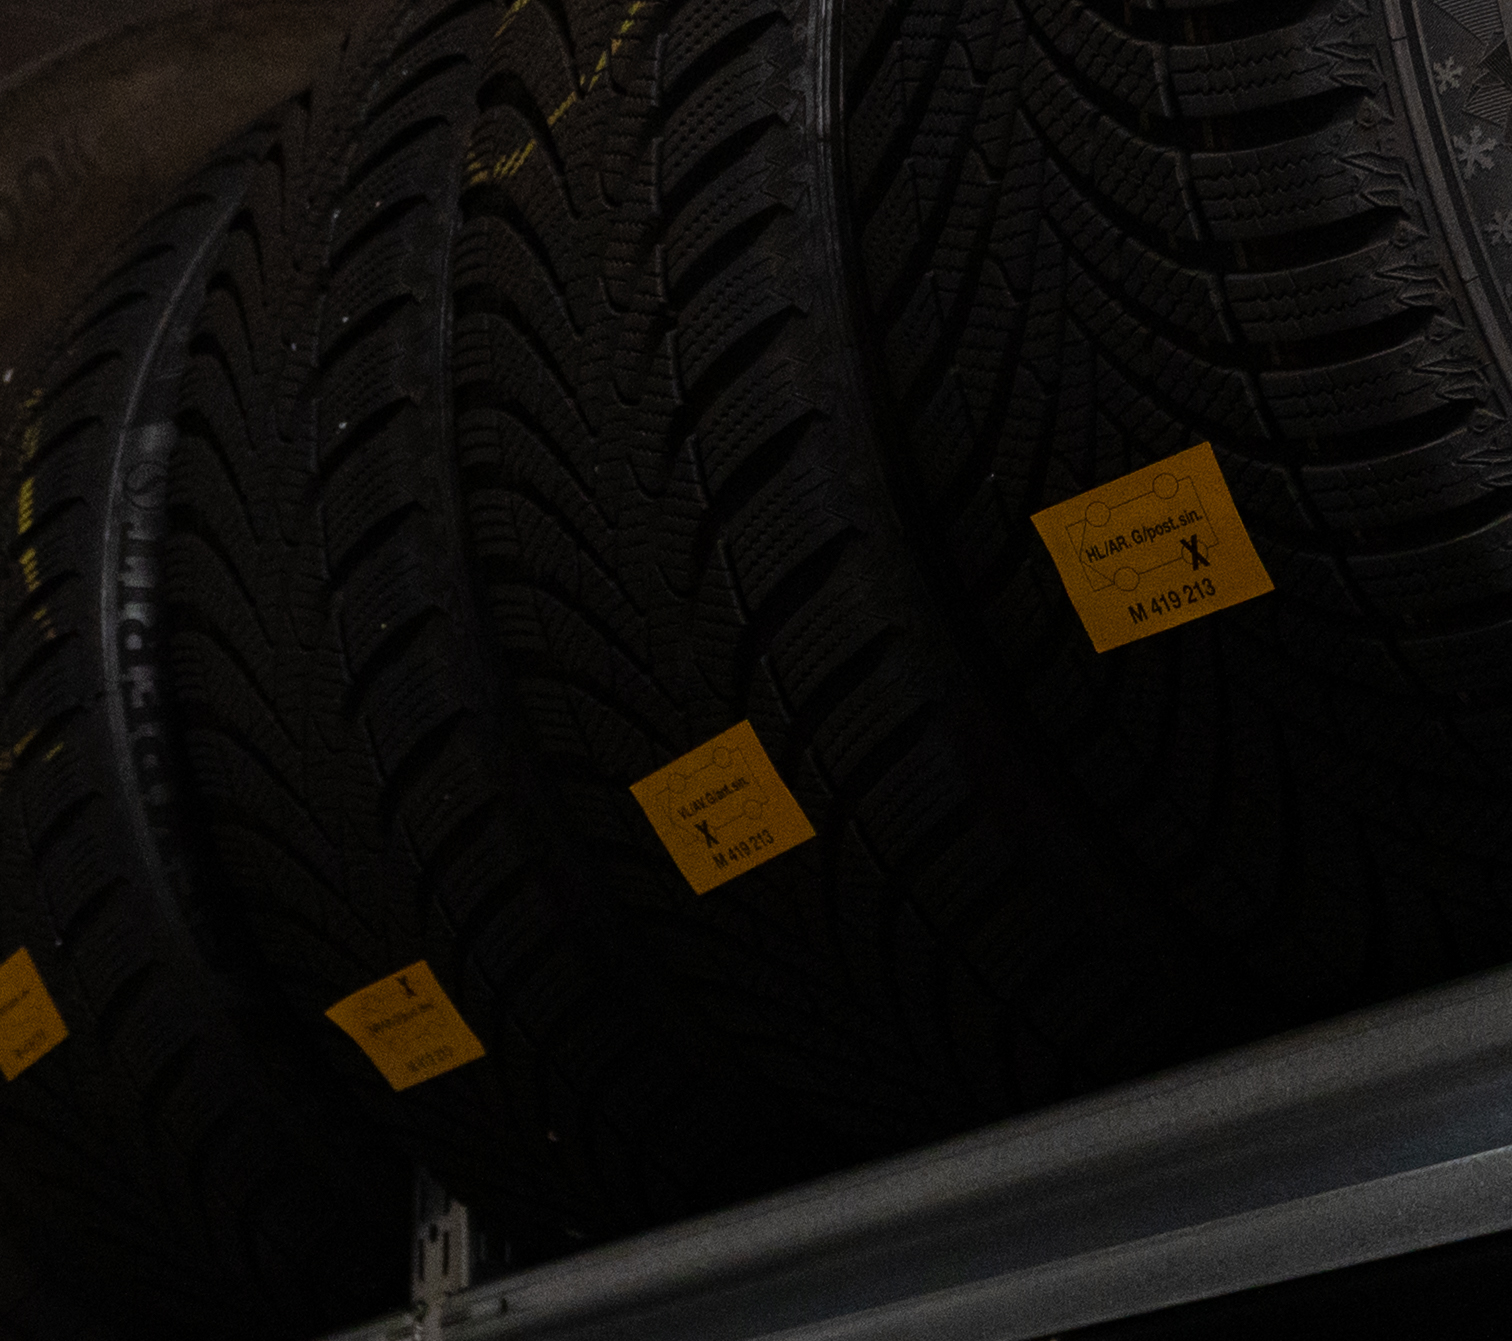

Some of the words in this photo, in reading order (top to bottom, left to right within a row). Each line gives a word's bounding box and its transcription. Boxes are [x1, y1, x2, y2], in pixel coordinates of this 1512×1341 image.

[1085, 535, 1131, 563] HL/AR.
[1131, 519, 1178, 547] G/post.
[1178, 508, 1203, 524] sin.
[1180, 534, 1210, 571] X
[1128, 603, 1148, 624] M
[1150, 590, 1182, 615] 419
[1182, 578, 1216, 605] 213
[694, 819, 720, 848] X
[713, 853, 728, 870] M
[749, 829, 775, 851] 213
